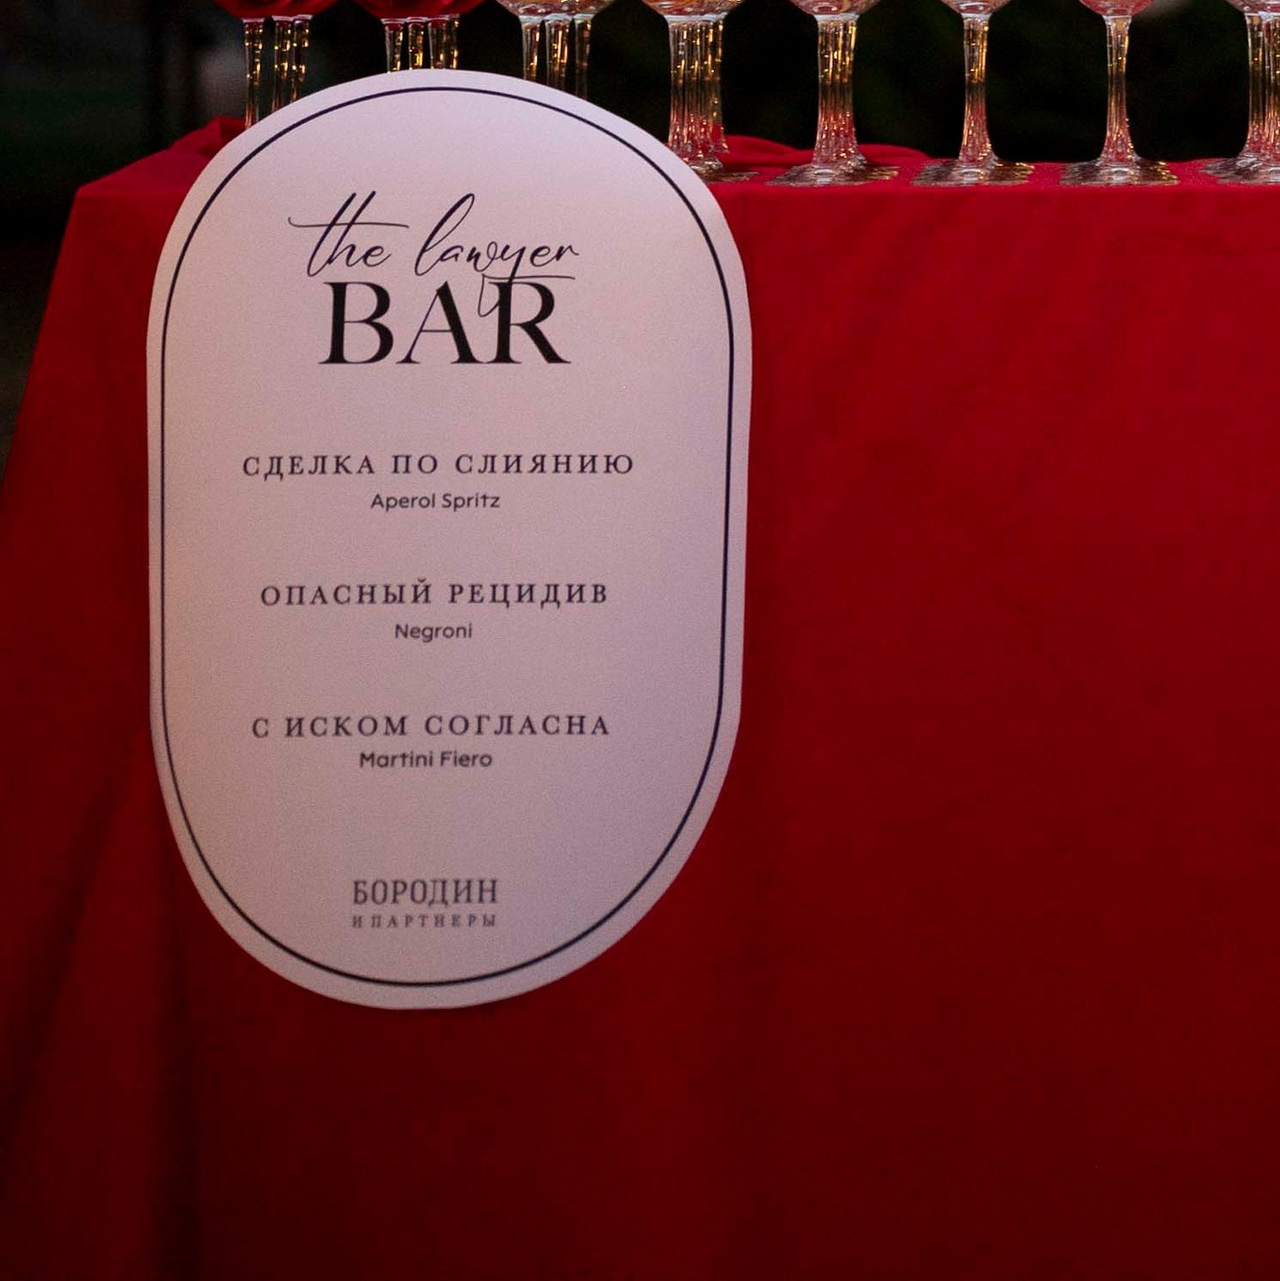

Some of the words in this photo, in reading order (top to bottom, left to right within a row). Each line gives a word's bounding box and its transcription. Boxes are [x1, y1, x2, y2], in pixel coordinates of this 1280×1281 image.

[288, 190, 409, 277] the
[413, 192, 579, 318] lawyer
[318, 280, 573, 365] BAR
[242, 454, 376, 481] СДЕЛКА
[390, 453, 439, 475] ПО
[454, 453, 634, 475] СЛИЯНИЮ
[370, 492, 436, 513] Aperol
[441, 492, 501, 513] Spritz
[260, 578, 433, 606] ОПАСНЫЙ
[447, 582, 608, 609] РЕЦИДИВ
[394, 621, 473, 643] Negroni
[251, 716, 270, 739] С
[284, 714, 409, 739] ИСКОМ
[423, 713, 610, 737] СОГЛАСНА
[358, 749, 434, 769] Martini
[439, 749, 494, 768] Fiero
[353, 878, 499, 909] БОРОДИН
